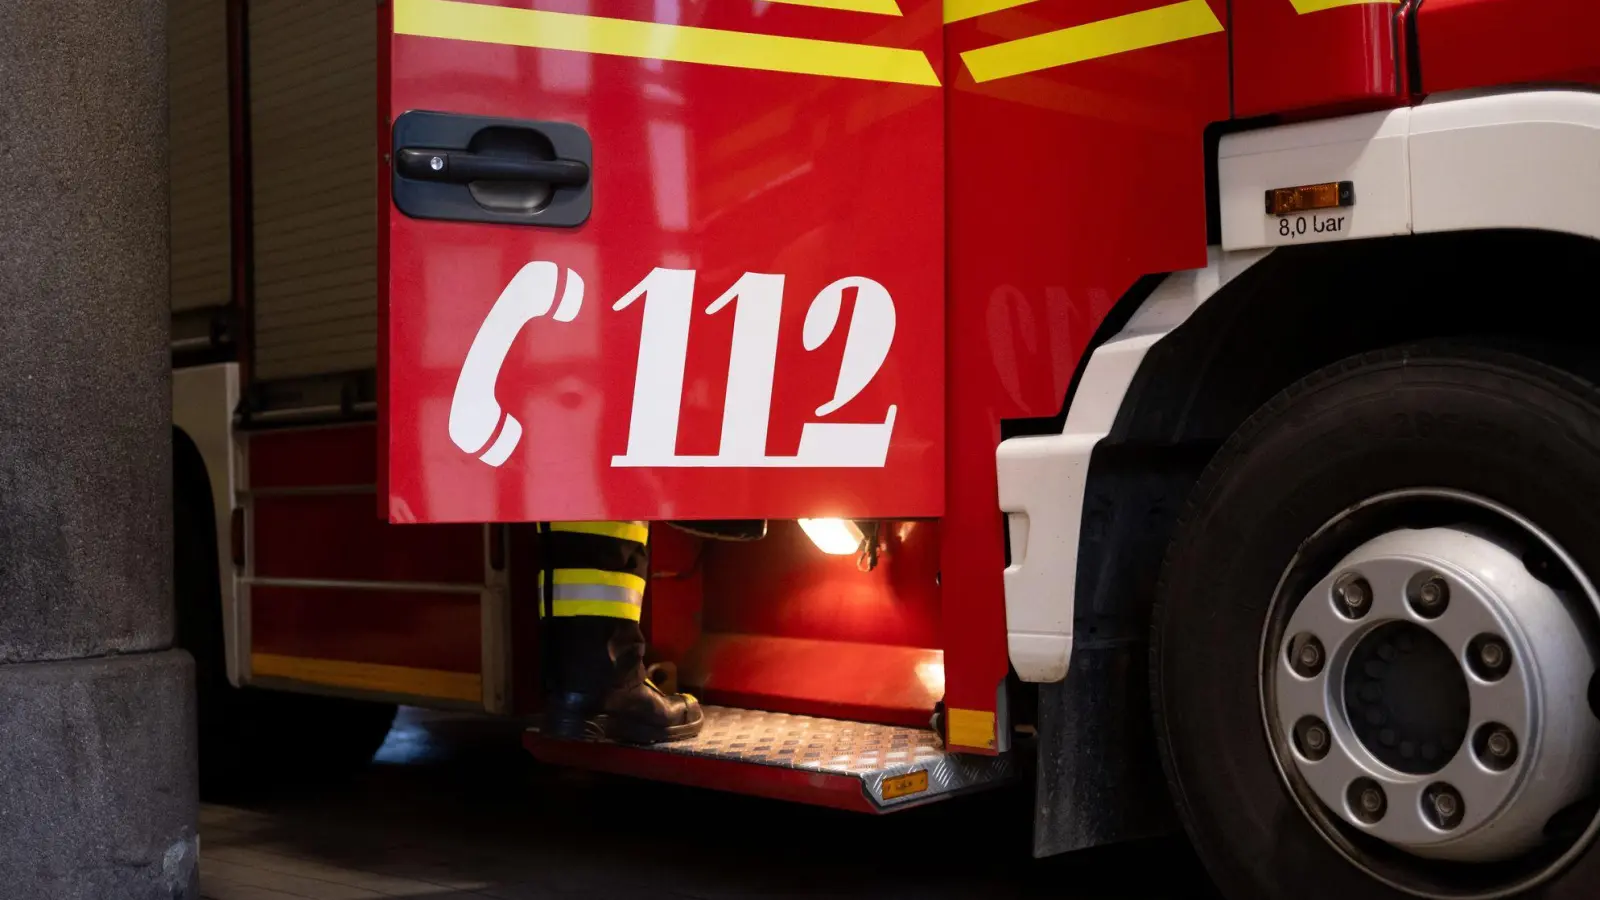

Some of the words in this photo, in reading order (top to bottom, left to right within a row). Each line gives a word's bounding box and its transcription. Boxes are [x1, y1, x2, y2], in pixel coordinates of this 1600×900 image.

[1279, 216, 1307, 239] 8,0
[1313, 214, 1345, 233] bar
[611, 267, 898, 468] 112
